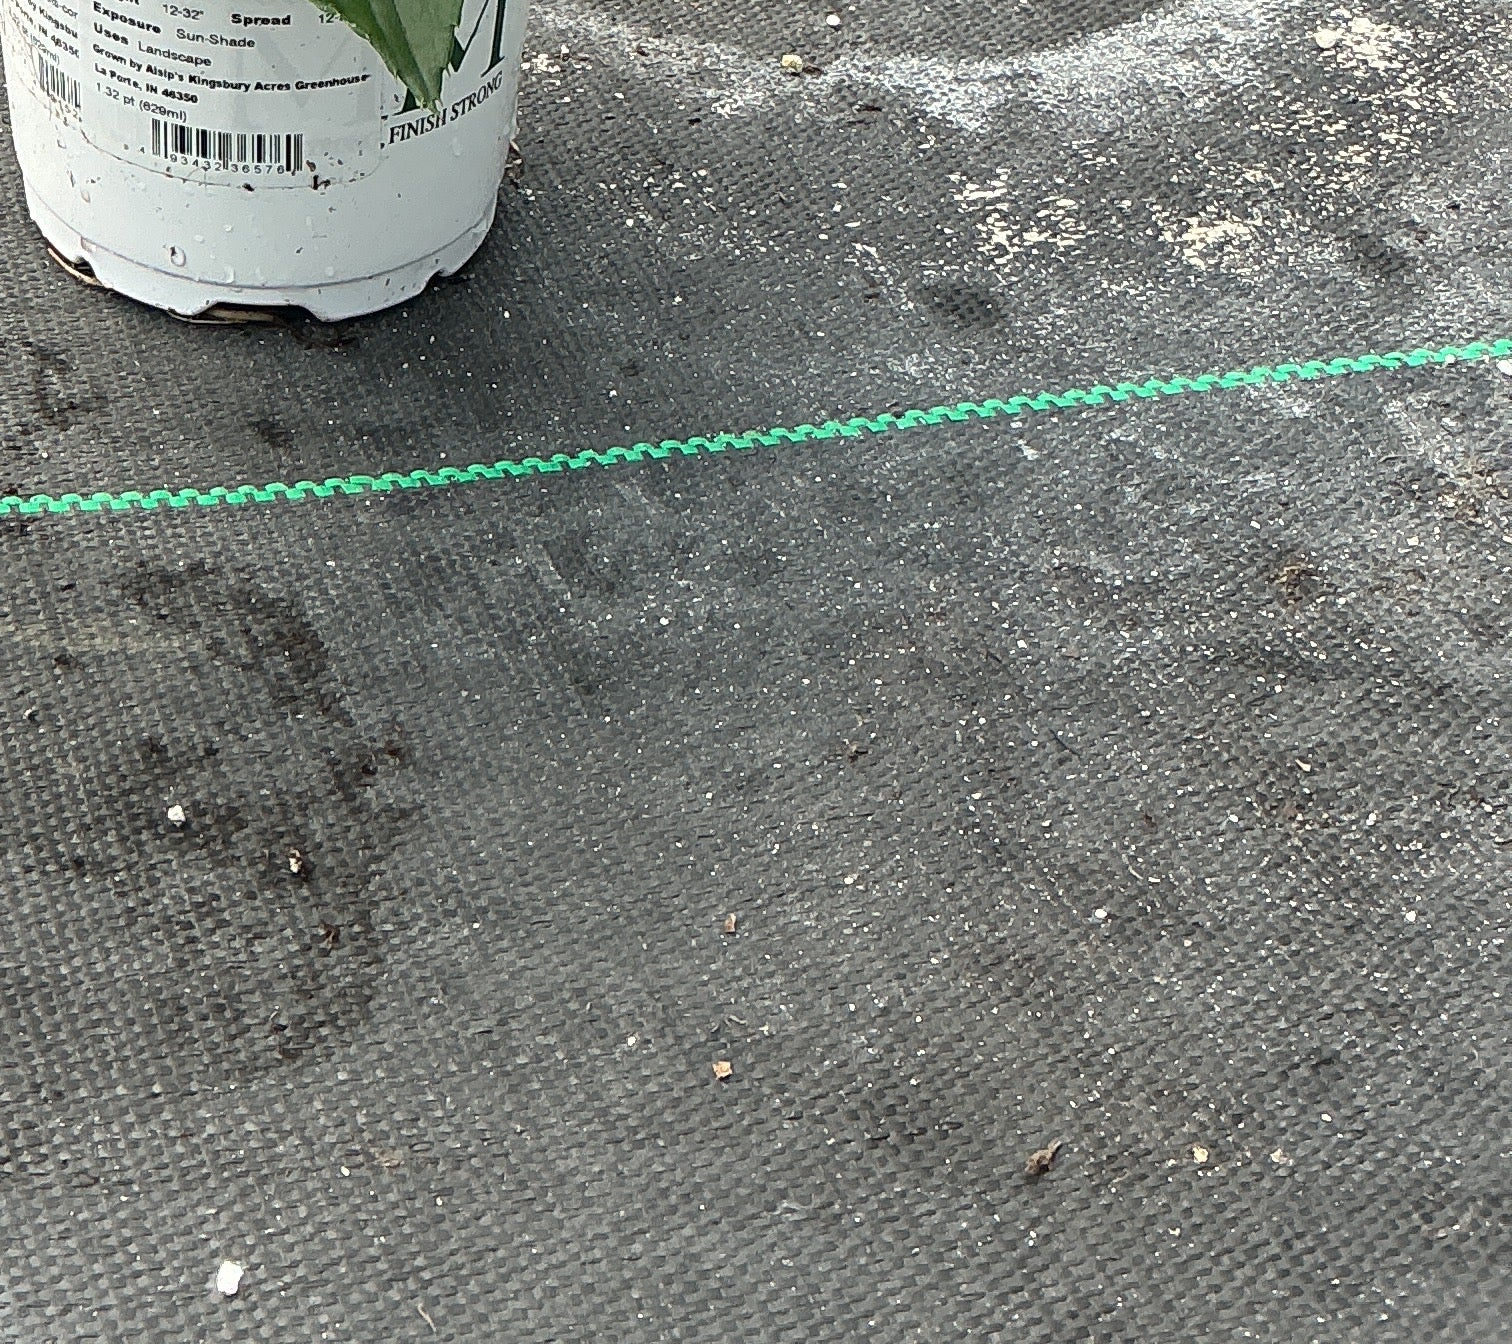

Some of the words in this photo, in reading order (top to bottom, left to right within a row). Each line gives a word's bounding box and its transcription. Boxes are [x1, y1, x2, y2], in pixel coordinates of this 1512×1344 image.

[92, 0, 162, 34] Exposure
[175, 28, 257, 49] Sun-Shade
[230, 13, 292, 28] Spread
[93, 21, 129, 46] Uses
[138, 40, 212, 67] Landscape
[92, 43, 127, 66] Grown
[129, 58, 143, 72] by
[188, 74, 251, 93] Kingsbury
[253, 81, 291, 92] Acres
[94, 62, 107, 76] La
[145, 82, 158, 95] IN
[123, 95, 135, 107] pt
[388, 111, 447, 145] FINISH
[449, 70, 504, 122] STRONG
